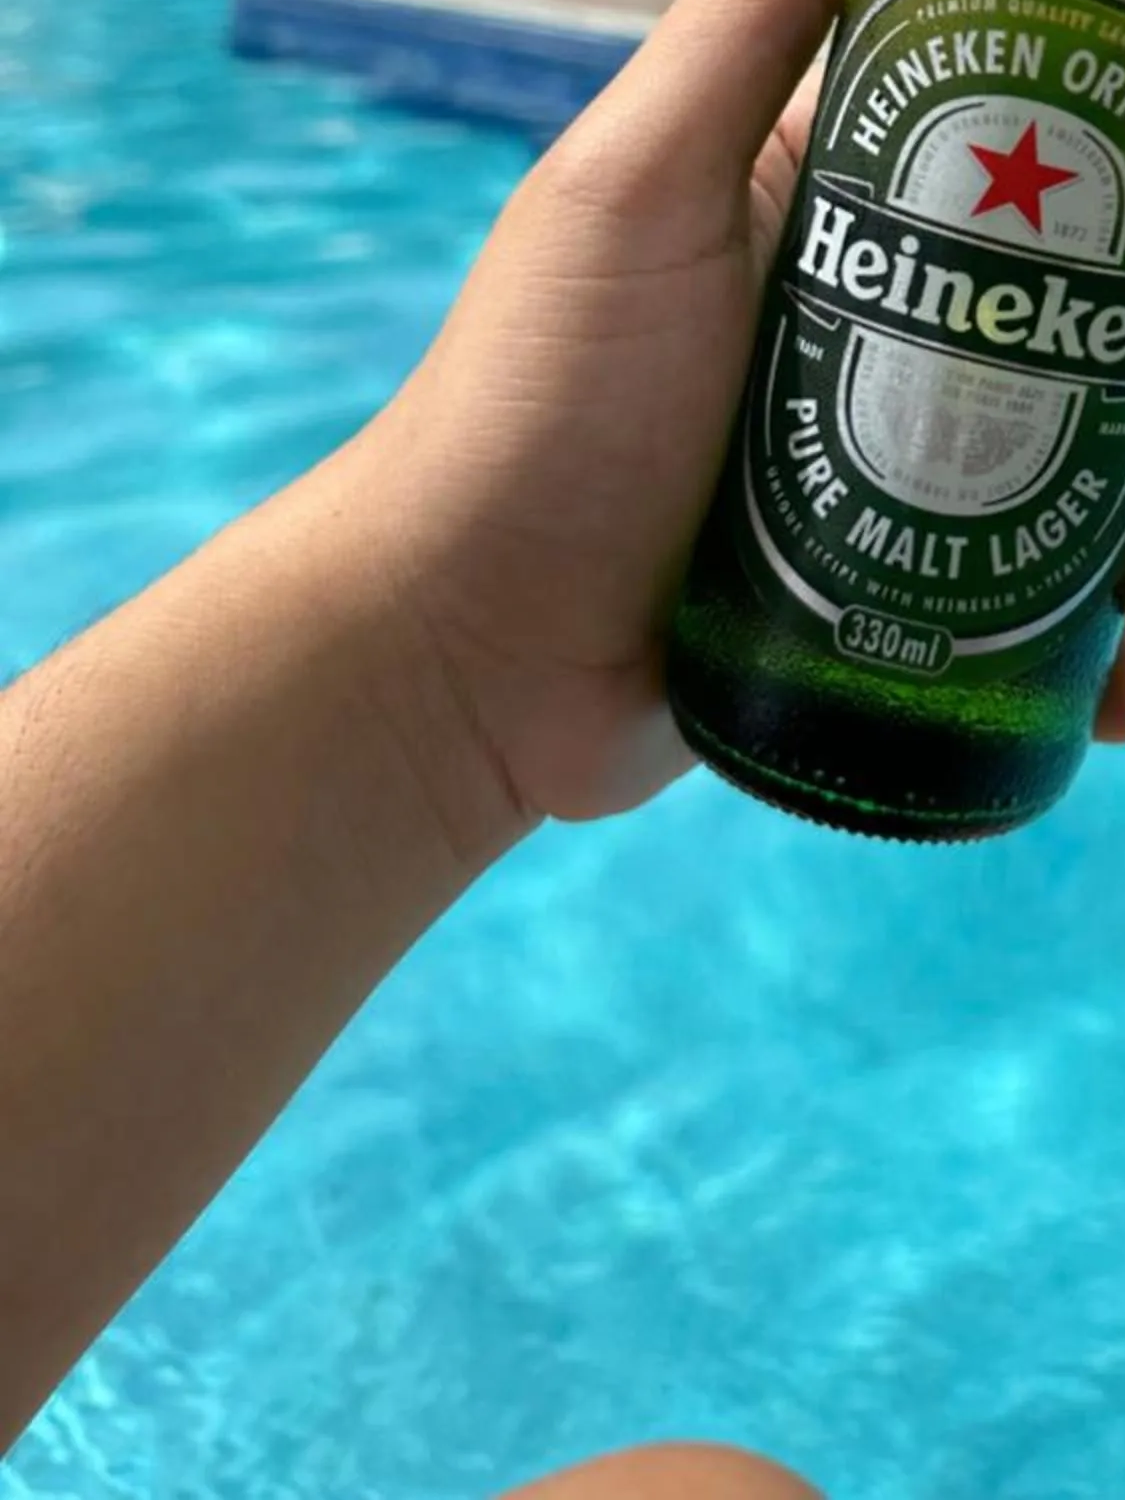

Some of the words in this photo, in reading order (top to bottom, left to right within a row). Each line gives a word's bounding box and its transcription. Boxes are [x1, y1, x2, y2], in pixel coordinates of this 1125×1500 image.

[851, 28, 1046, 158] HEINEKEN
[786, 398, 849, 519] PURE
[845, 506, 969, 580] MALT
[989, 468, 1109, 578] LAGER
[846, 613, 941, 668] 330ml
